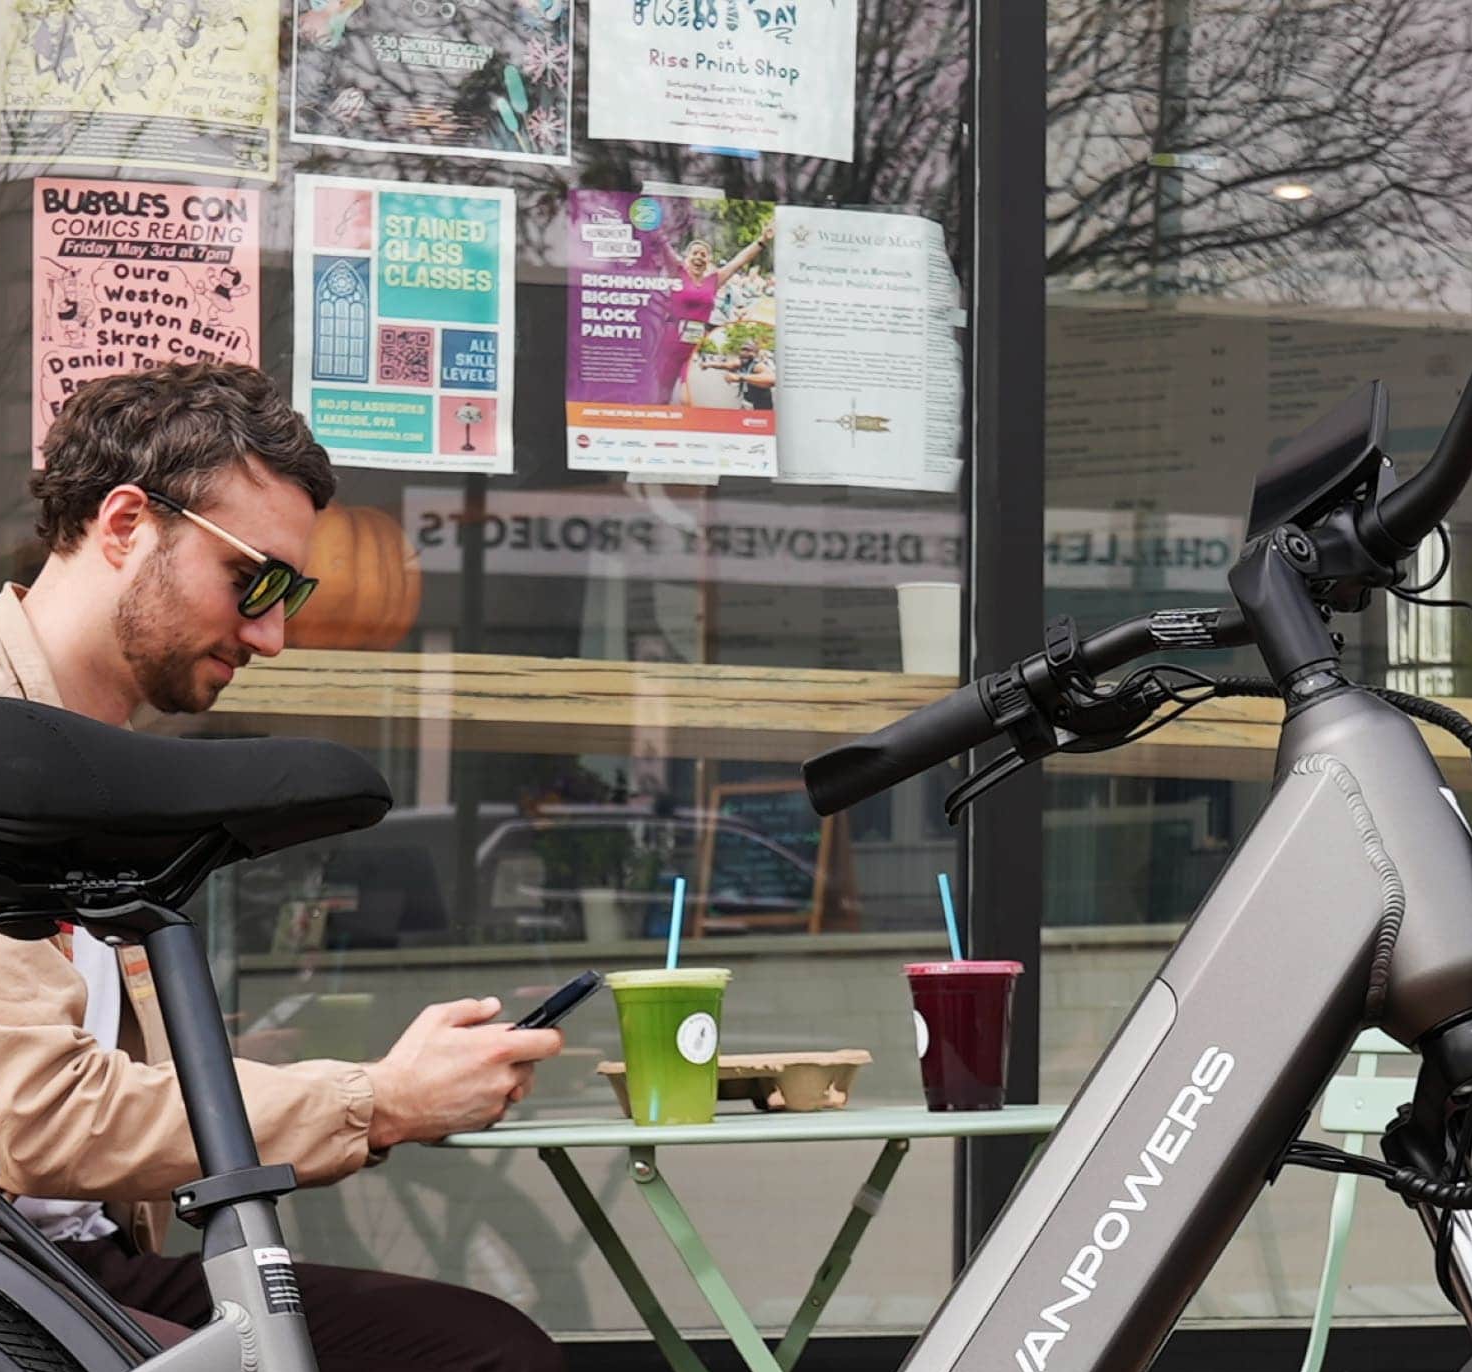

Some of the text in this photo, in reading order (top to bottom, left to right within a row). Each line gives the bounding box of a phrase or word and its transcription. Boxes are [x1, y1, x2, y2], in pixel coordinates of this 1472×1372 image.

[754, 6, 798, 29] DAY
[717, 38, 734, 51] at
[649, 48, 801, 86] Rise Print Shop
[42, 187, 248, 223] BUBBLES CON
[51, 218, 244, 243] COMICS READING
[384, 214, 487, 243] STAINED
[63, 240, 230, 262] Friday May 3rd at 7pm
[384, 239, 464, 265] GLASS
[113, 263, 170, 283] Oura
[384, 264, 493, 292] CLASSES
[581, 273, 684, 291] RICHMOND'S
[103, 285, 189, 310] Weston
[581, 290, 652, 307] BIGGEST
[581, 308, 637, 323] BLOCK
[97, 329, 160, 350] Skrat
[100, 307, 241, 350] Payton Baril
[581, 324, 642, 340] PARTY!
[469, 339, 496, 354] ALL
[48, 349, 124, 374] Daniel
[455, 354, 496, 369] SKILL
[442, 367, 496, 383] LEVELS
